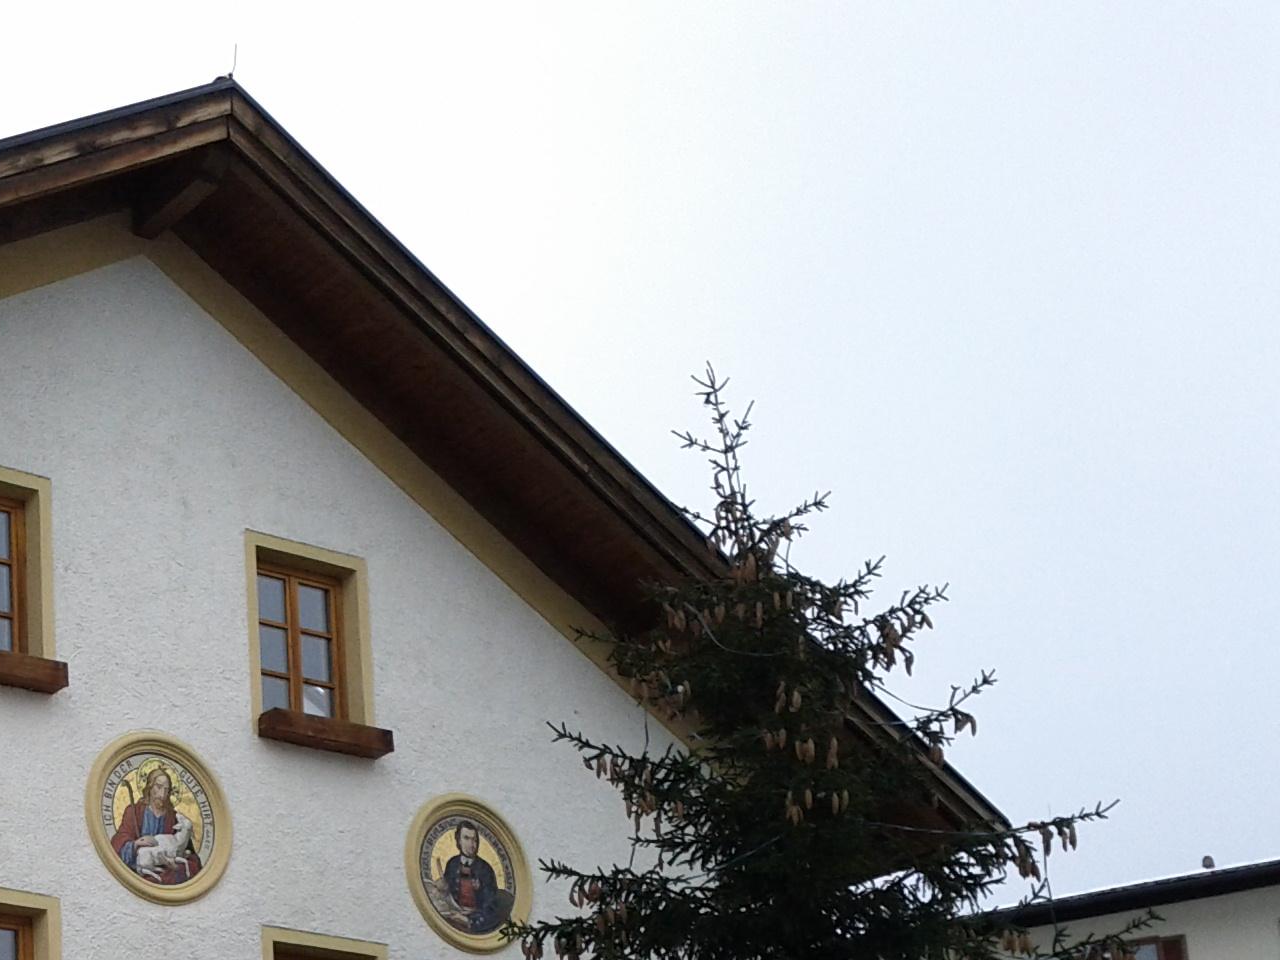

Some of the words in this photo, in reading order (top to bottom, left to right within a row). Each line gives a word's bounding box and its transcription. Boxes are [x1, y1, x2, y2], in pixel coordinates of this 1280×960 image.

[113, 760, 133, 779] DER
[103, 779, 117, 799] BIN
[180, 769, 203, 797] GUTE
[103, 804, 113, 826] ICH
[200, 801, 213, 826] HIRT
